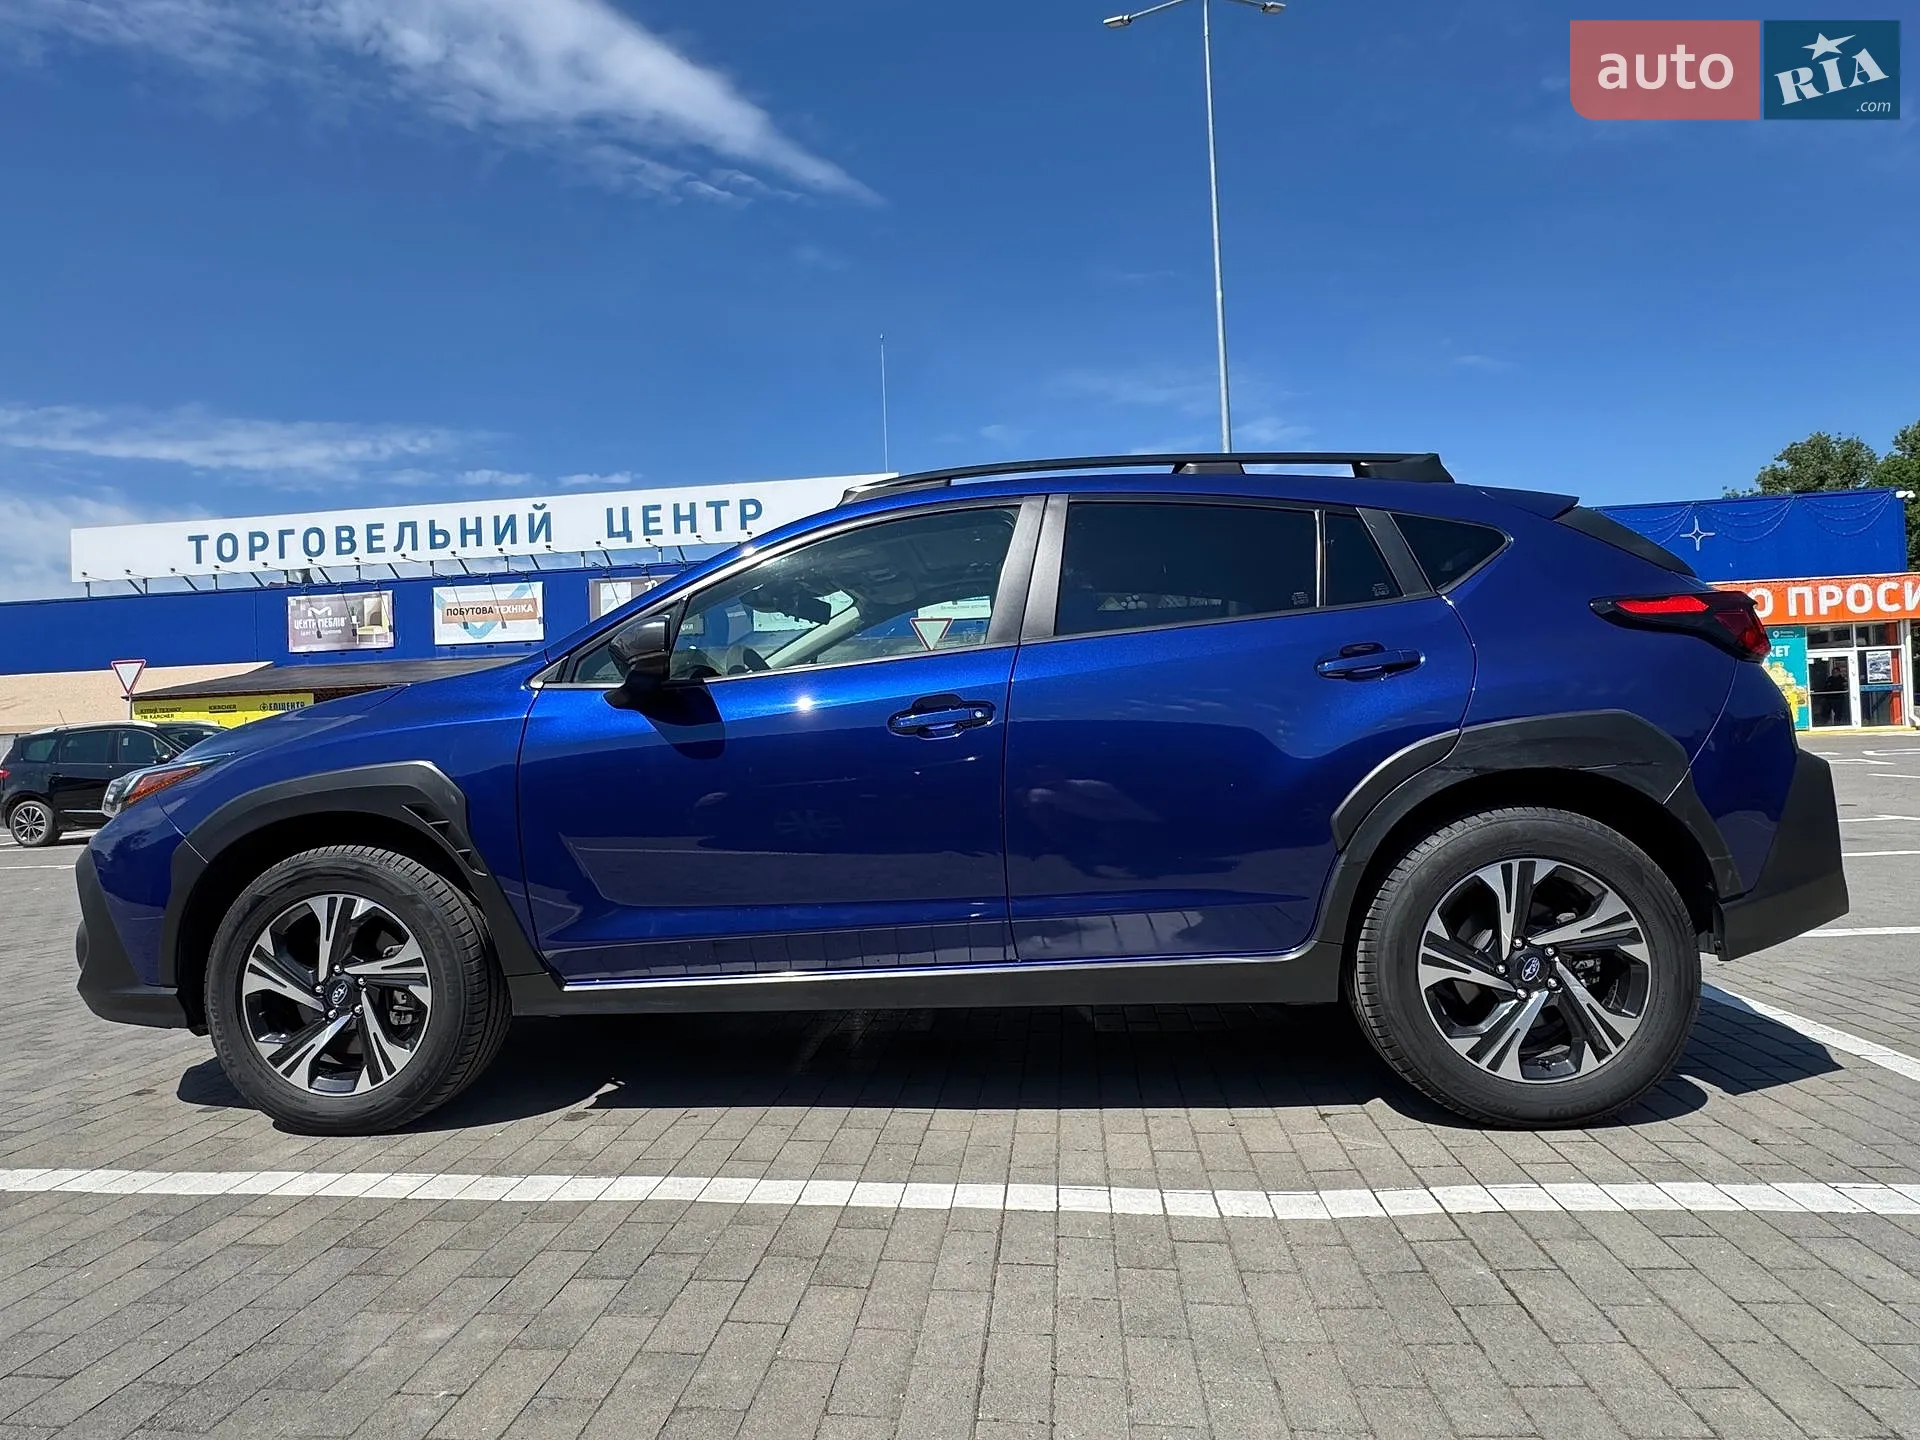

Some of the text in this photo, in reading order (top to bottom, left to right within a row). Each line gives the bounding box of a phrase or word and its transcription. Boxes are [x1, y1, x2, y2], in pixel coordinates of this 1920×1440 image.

[187, 498, 763, 565] ТОРГОВЕЛЬНИЙ ЦЕНТР
[446, 604, 534, 617] ПОБУТОВА ТЕХНІКА
